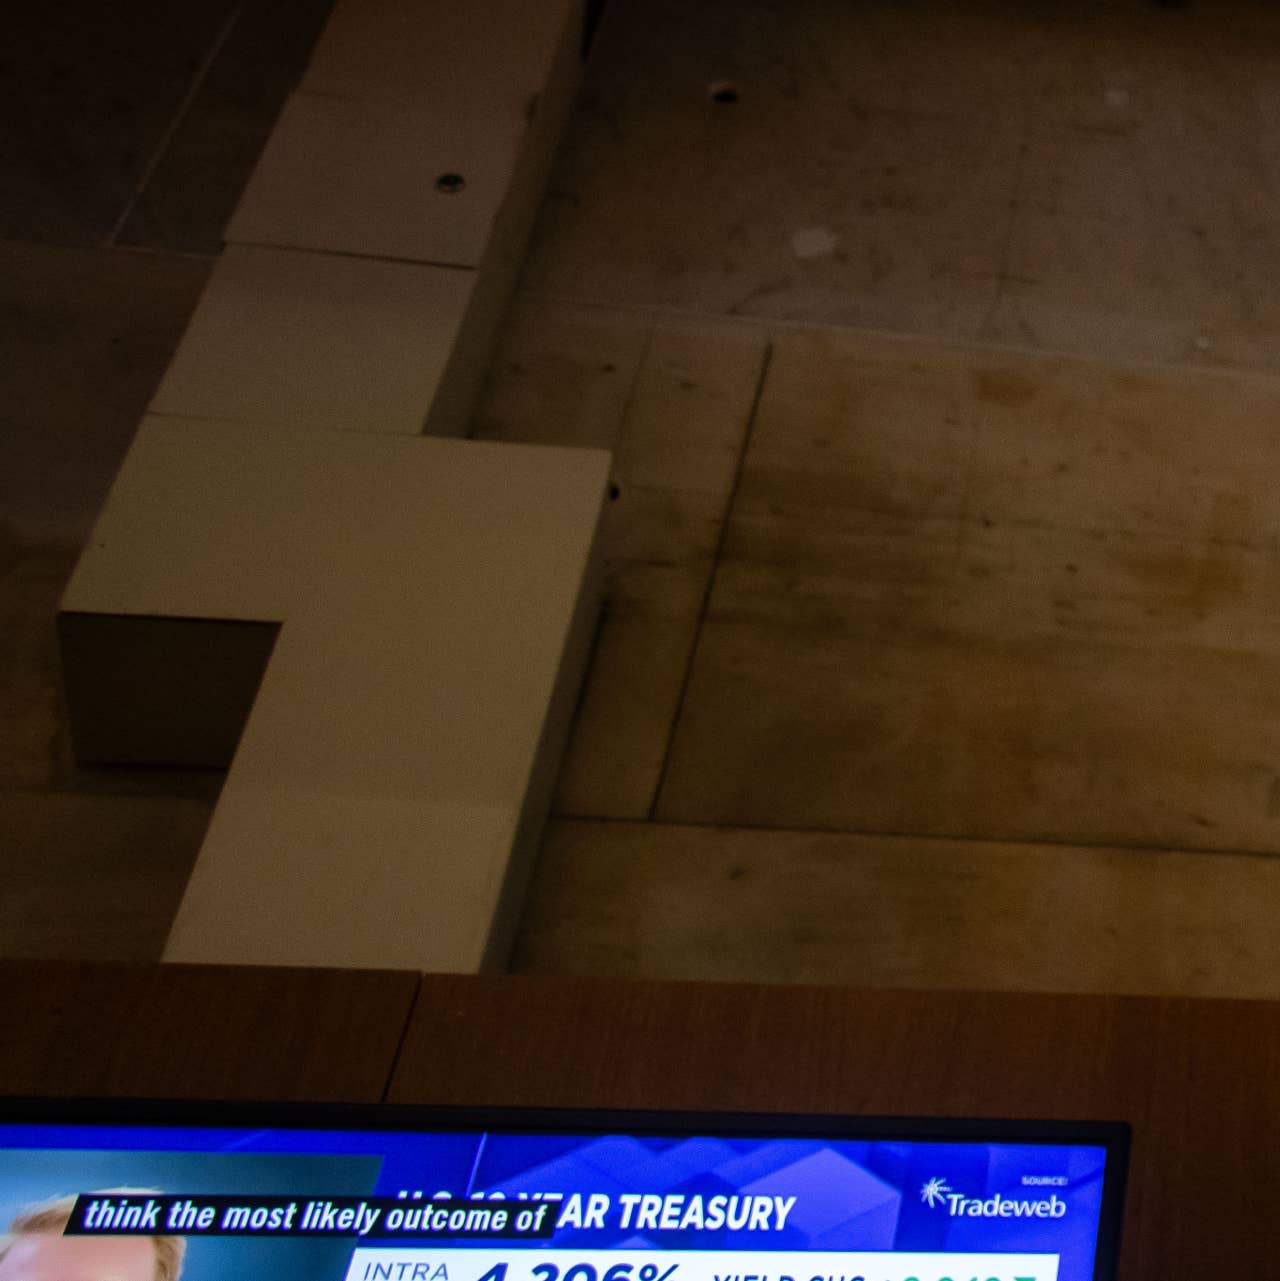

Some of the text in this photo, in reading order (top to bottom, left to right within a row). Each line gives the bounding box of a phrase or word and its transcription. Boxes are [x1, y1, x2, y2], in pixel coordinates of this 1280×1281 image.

[83, 1200, 548, 1235] think the most likely outcome of
[618, 1194, 796, 1231] TREASURY
[946, 1193, 1067, 1218] Tradeweb
